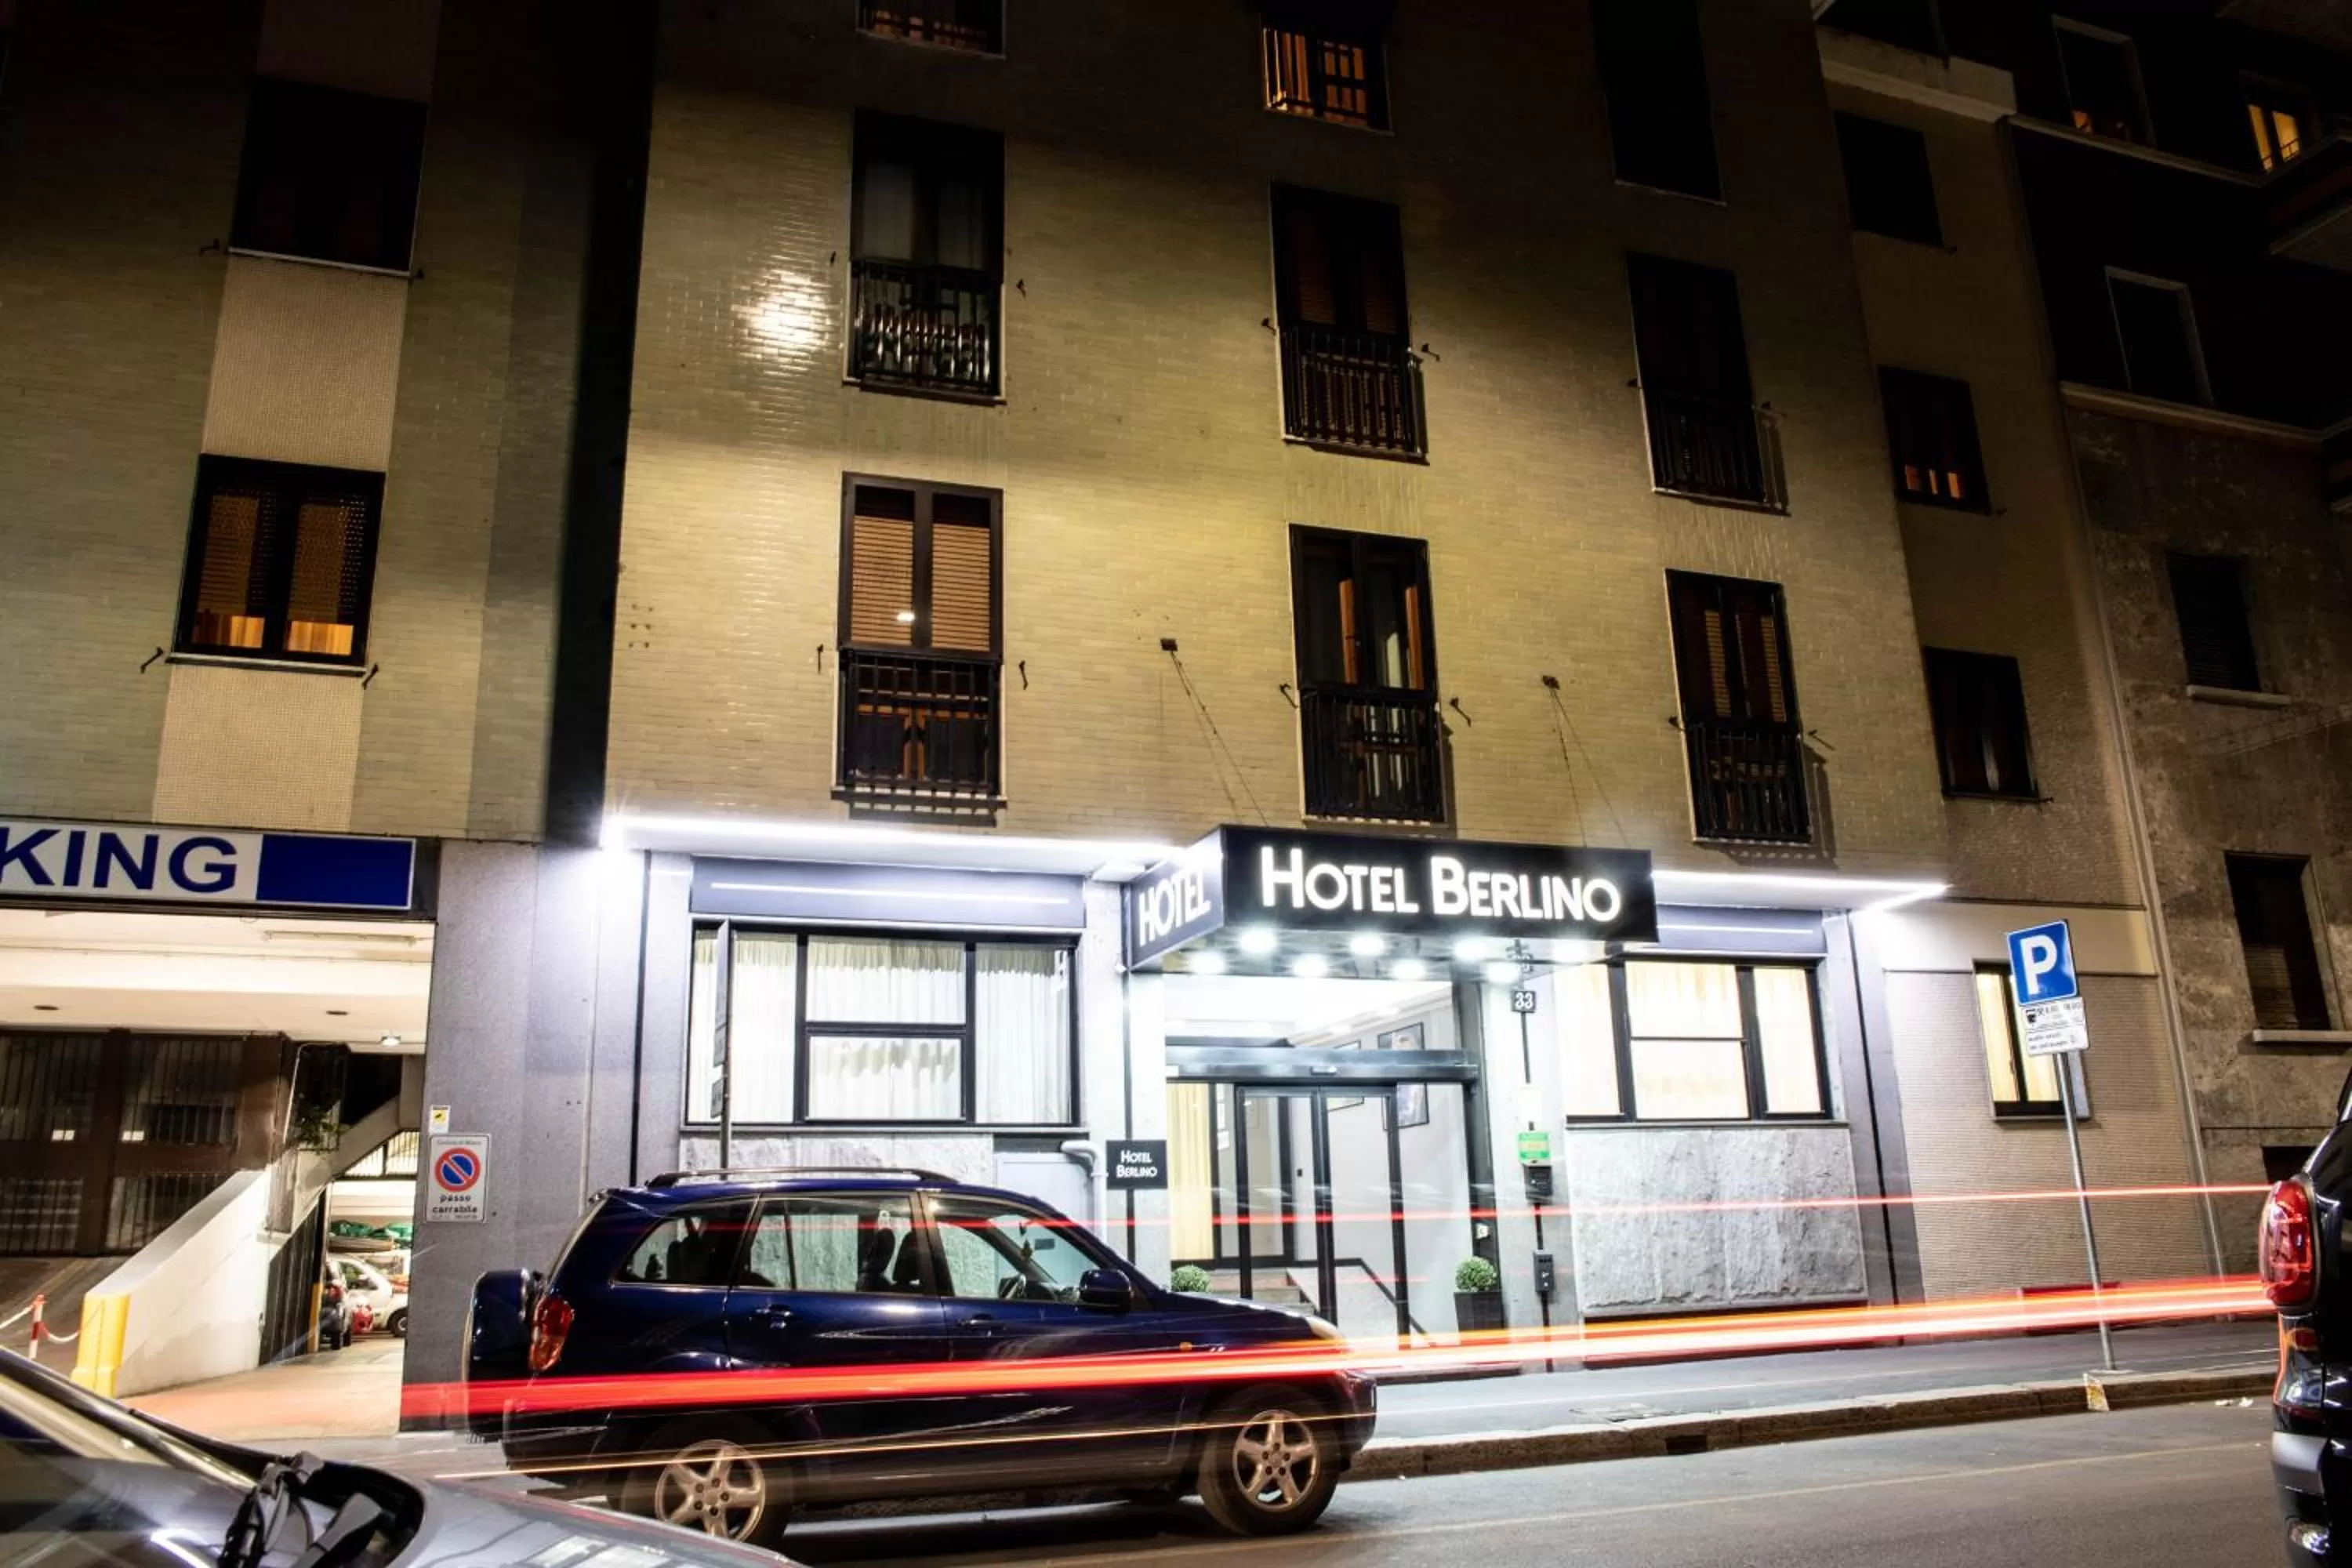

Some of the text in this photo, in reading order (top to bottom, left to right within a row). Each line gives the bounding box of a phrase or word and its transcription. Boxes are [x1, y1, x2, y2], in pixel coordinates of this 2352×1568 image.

[0, 827, 238, 893] KING
[1261, 845, 1621, 922] HOTEL BERLINO
[1138, 866, 1211, 947] HOTEL
[2019, 935, 2058, 996] P
[1514, 991, 1534, 1010] 33
[1116, 1164, 1158, 1178] BERLINO
[1120, 1149, 1152, 1163] HOTEL
[440, 1194, 471, 1203] passo
